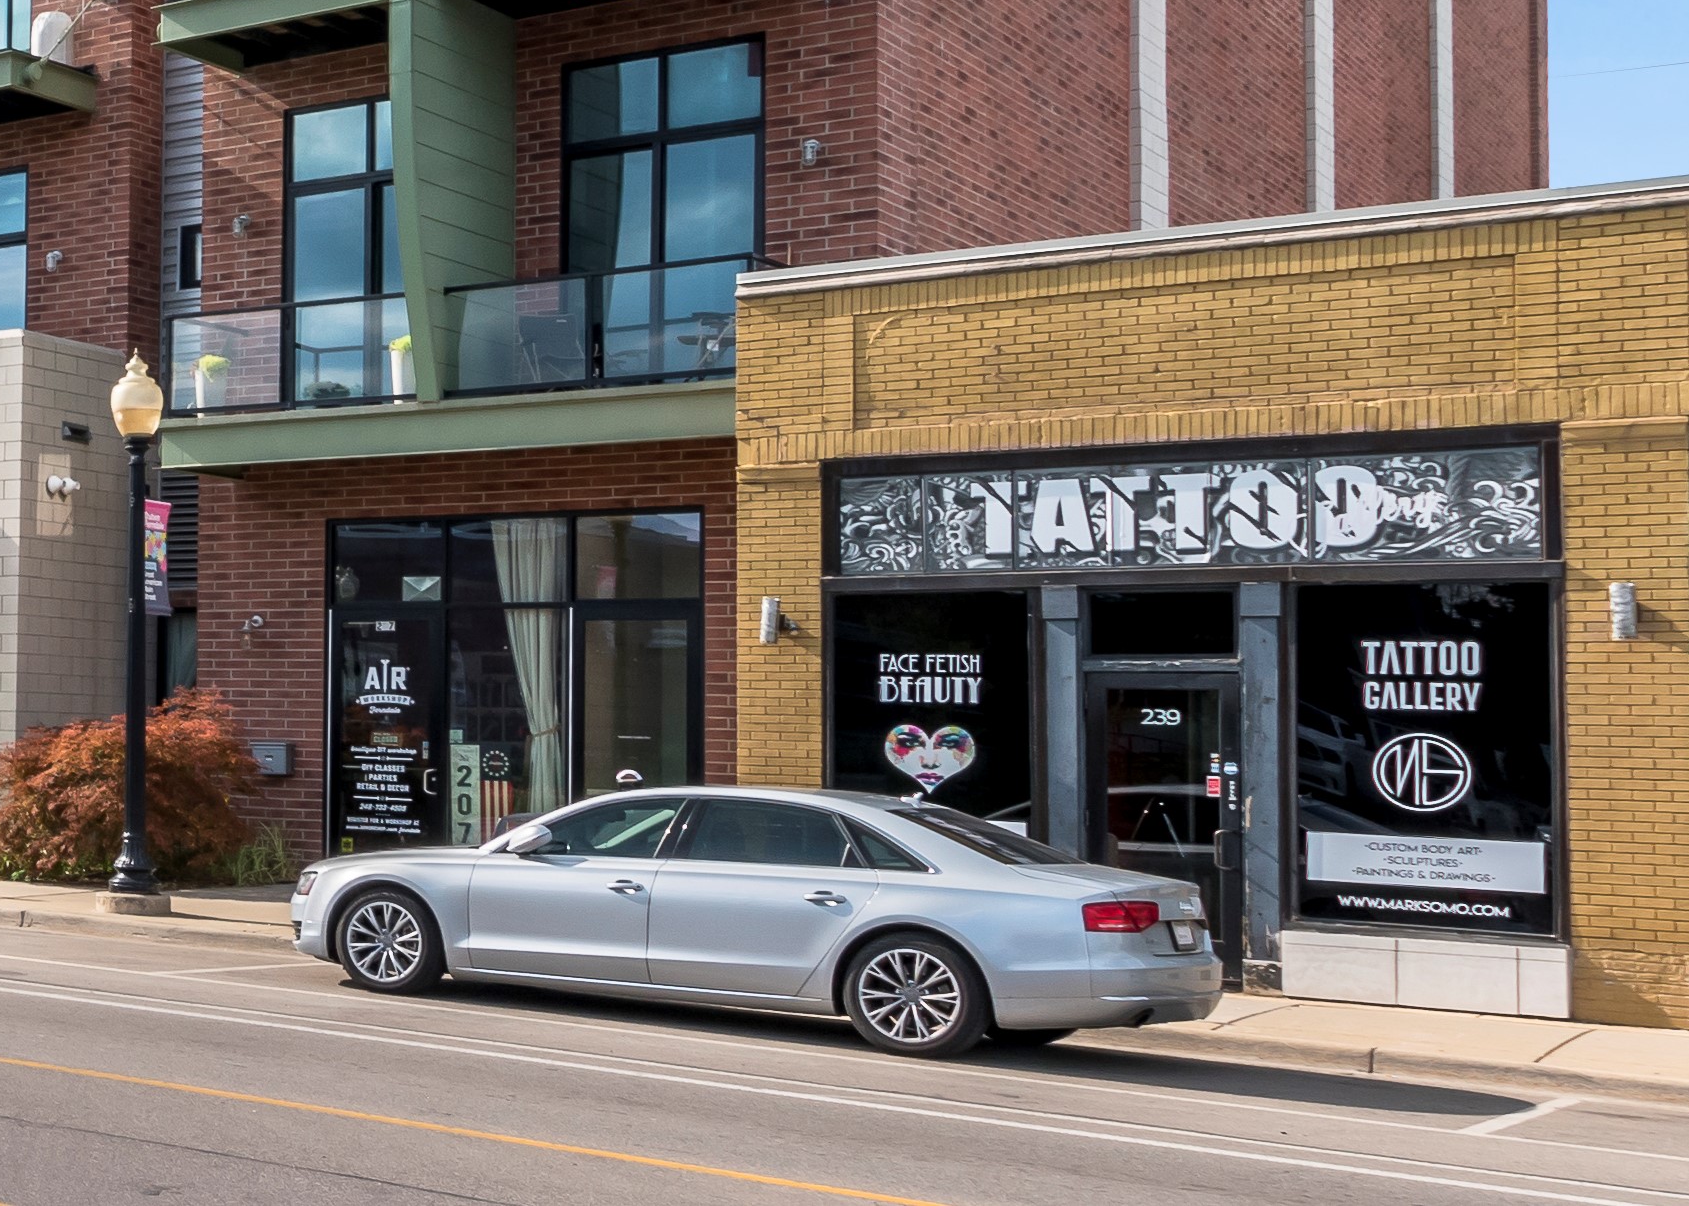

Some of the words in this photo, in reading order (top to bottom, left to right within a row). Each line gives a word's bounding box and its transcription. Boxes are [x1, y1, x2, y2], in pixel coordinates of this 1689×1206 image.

[970, 465, 1379, 556] TATTOO
[377, 620, 395, 631] 27
[879, 653, 920, 673] FACE
[924, 654, 981, 674] FETISH
[1362, 640, 1481, 677] TATTOO
[878, 676, 983, 704] BEAUTY
[1363, 680, 1482, 712] GALLERY
[362, 695, 409, 704] WORKSHOP
[1140, 708, 1182, 726] 239
[361, 763, 373, 771] DIY
[374, 764, 405, 773] CLASSES
[356, 782, 379, 791] RETAIL
[387, 784, 410, 792] DECOR
[368, 774, 398, 782] PARTIES
[456, 764, 472, 844] 207
[1421, 844, 1453, 855] BODY
[1417, 870, 1427, 880] &
[1337, 894, 1511, 919] WWW.MARKSOMO.COM
